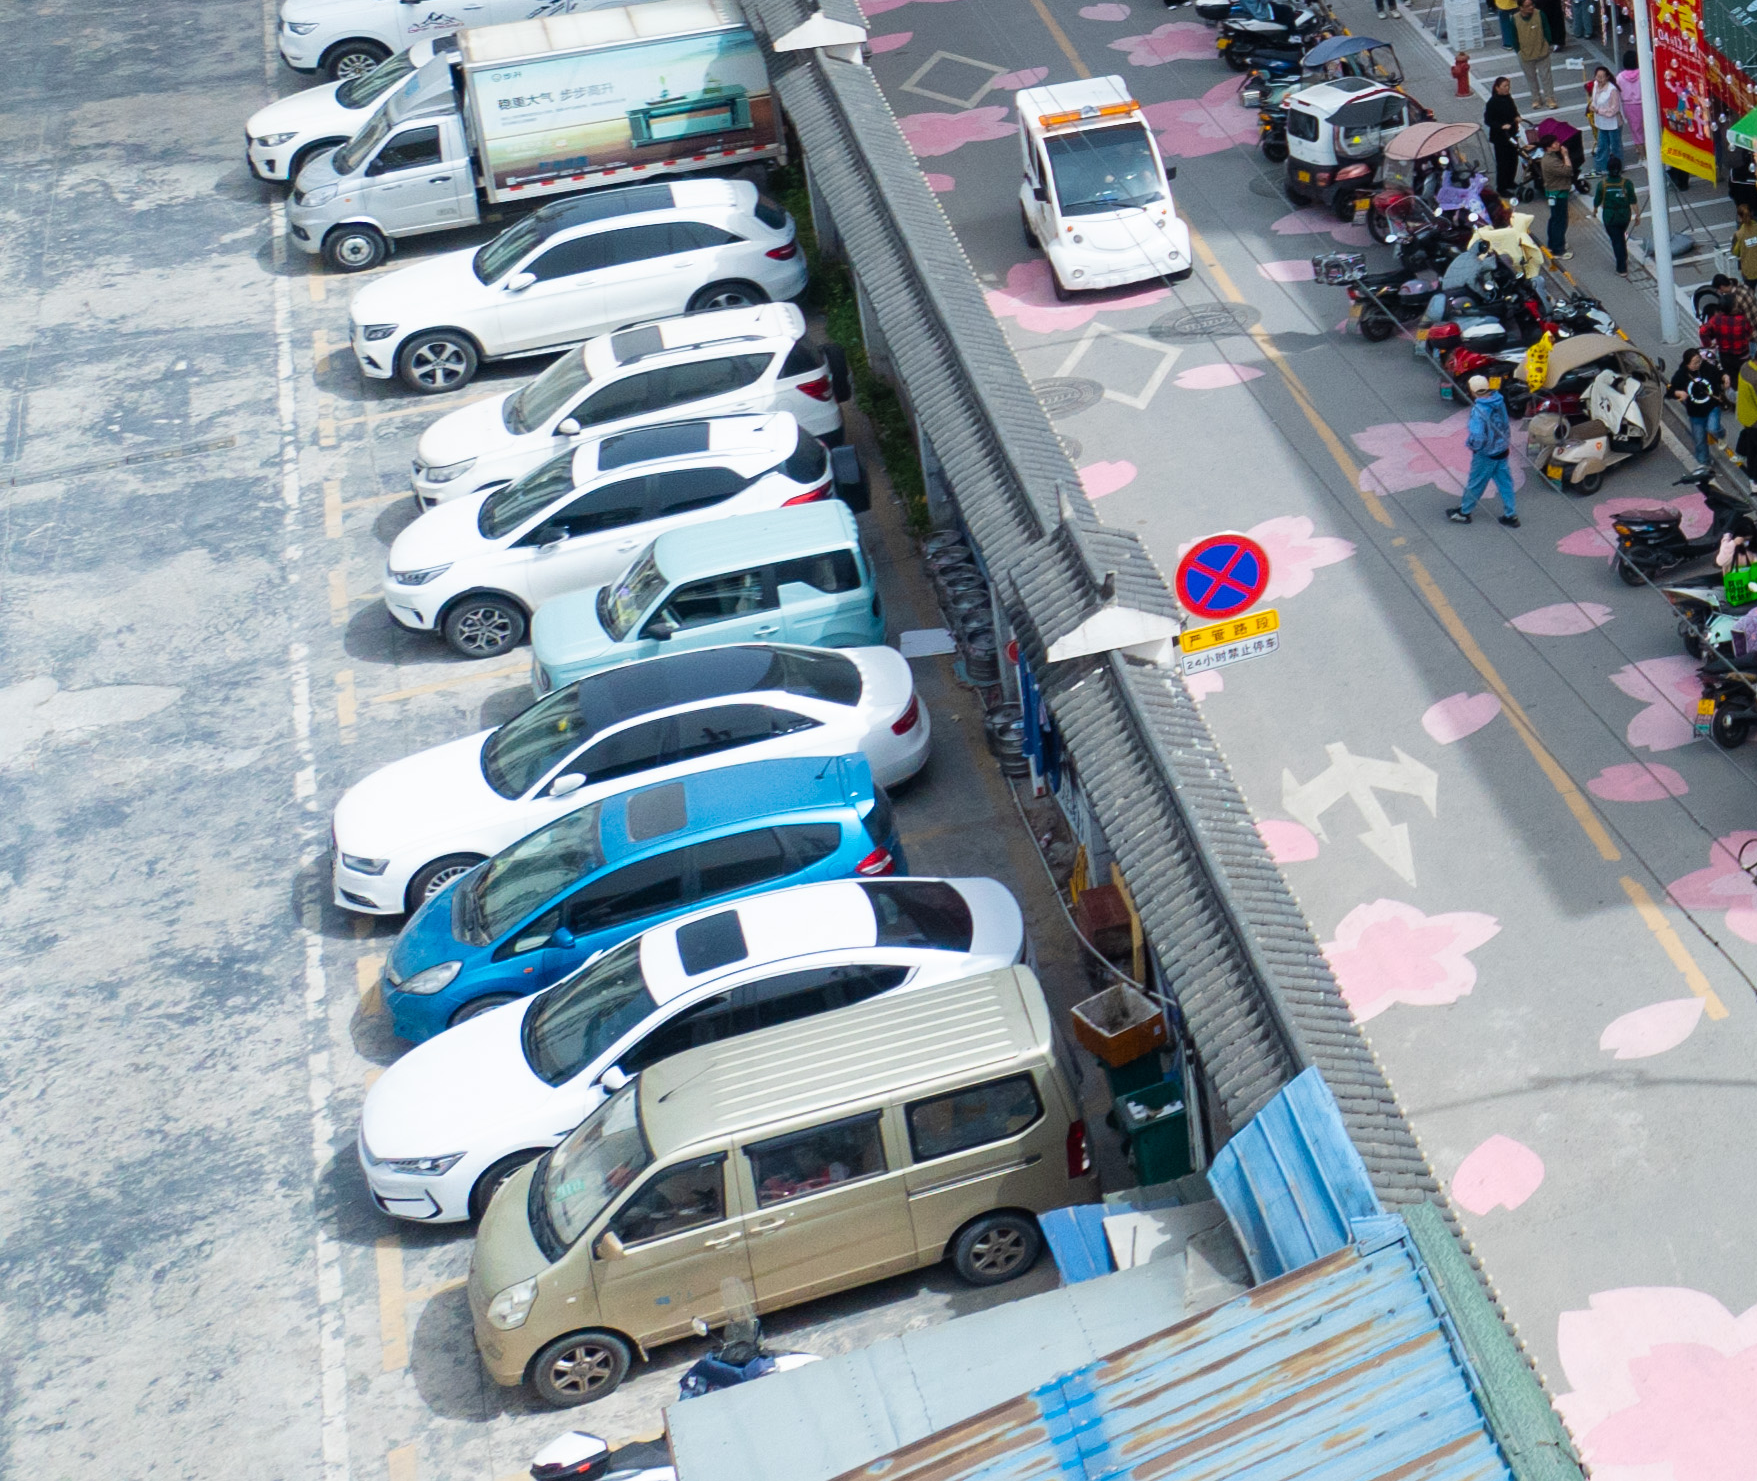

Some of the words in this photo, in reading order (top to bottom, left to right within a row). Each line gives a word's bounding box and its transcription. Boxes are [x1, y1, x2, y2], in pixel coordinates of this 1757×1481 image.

[1190, 617, 1269, 648] 严管路段
[1187, 637, 1277, 670] 24小时禁止停车
